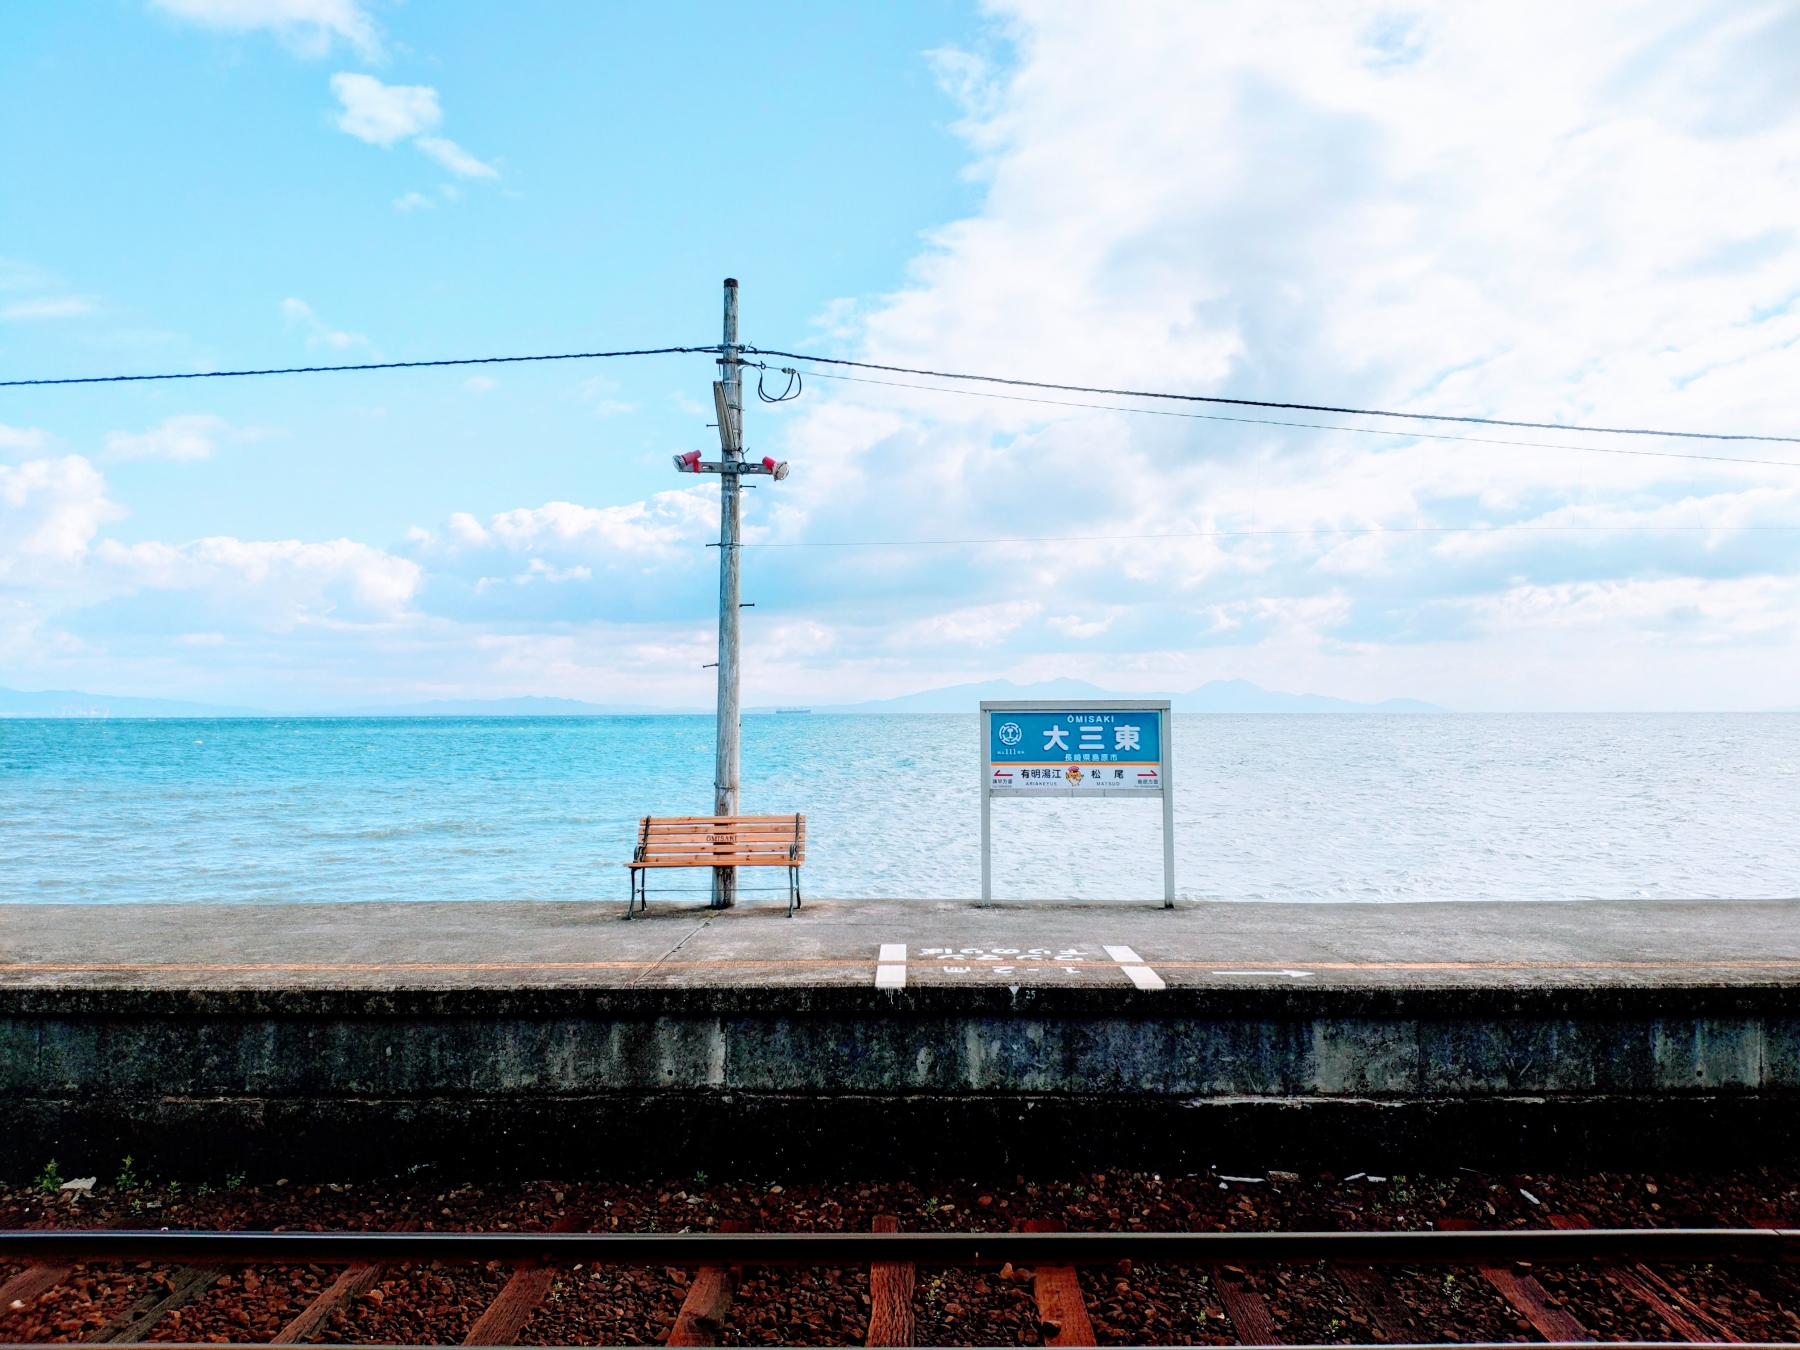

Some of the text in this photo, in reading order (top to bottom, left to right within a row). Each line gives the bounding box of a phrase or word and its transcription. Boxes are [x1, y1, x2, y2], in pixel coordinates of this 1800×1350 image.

[1042, 724, 1141, 751] 大三東
[1064, 753, 1118, 762] 長崎県島原市
[1020, 768, 1062, 779] 有明湯江
[1025, 990, 1036, 1000] 25
